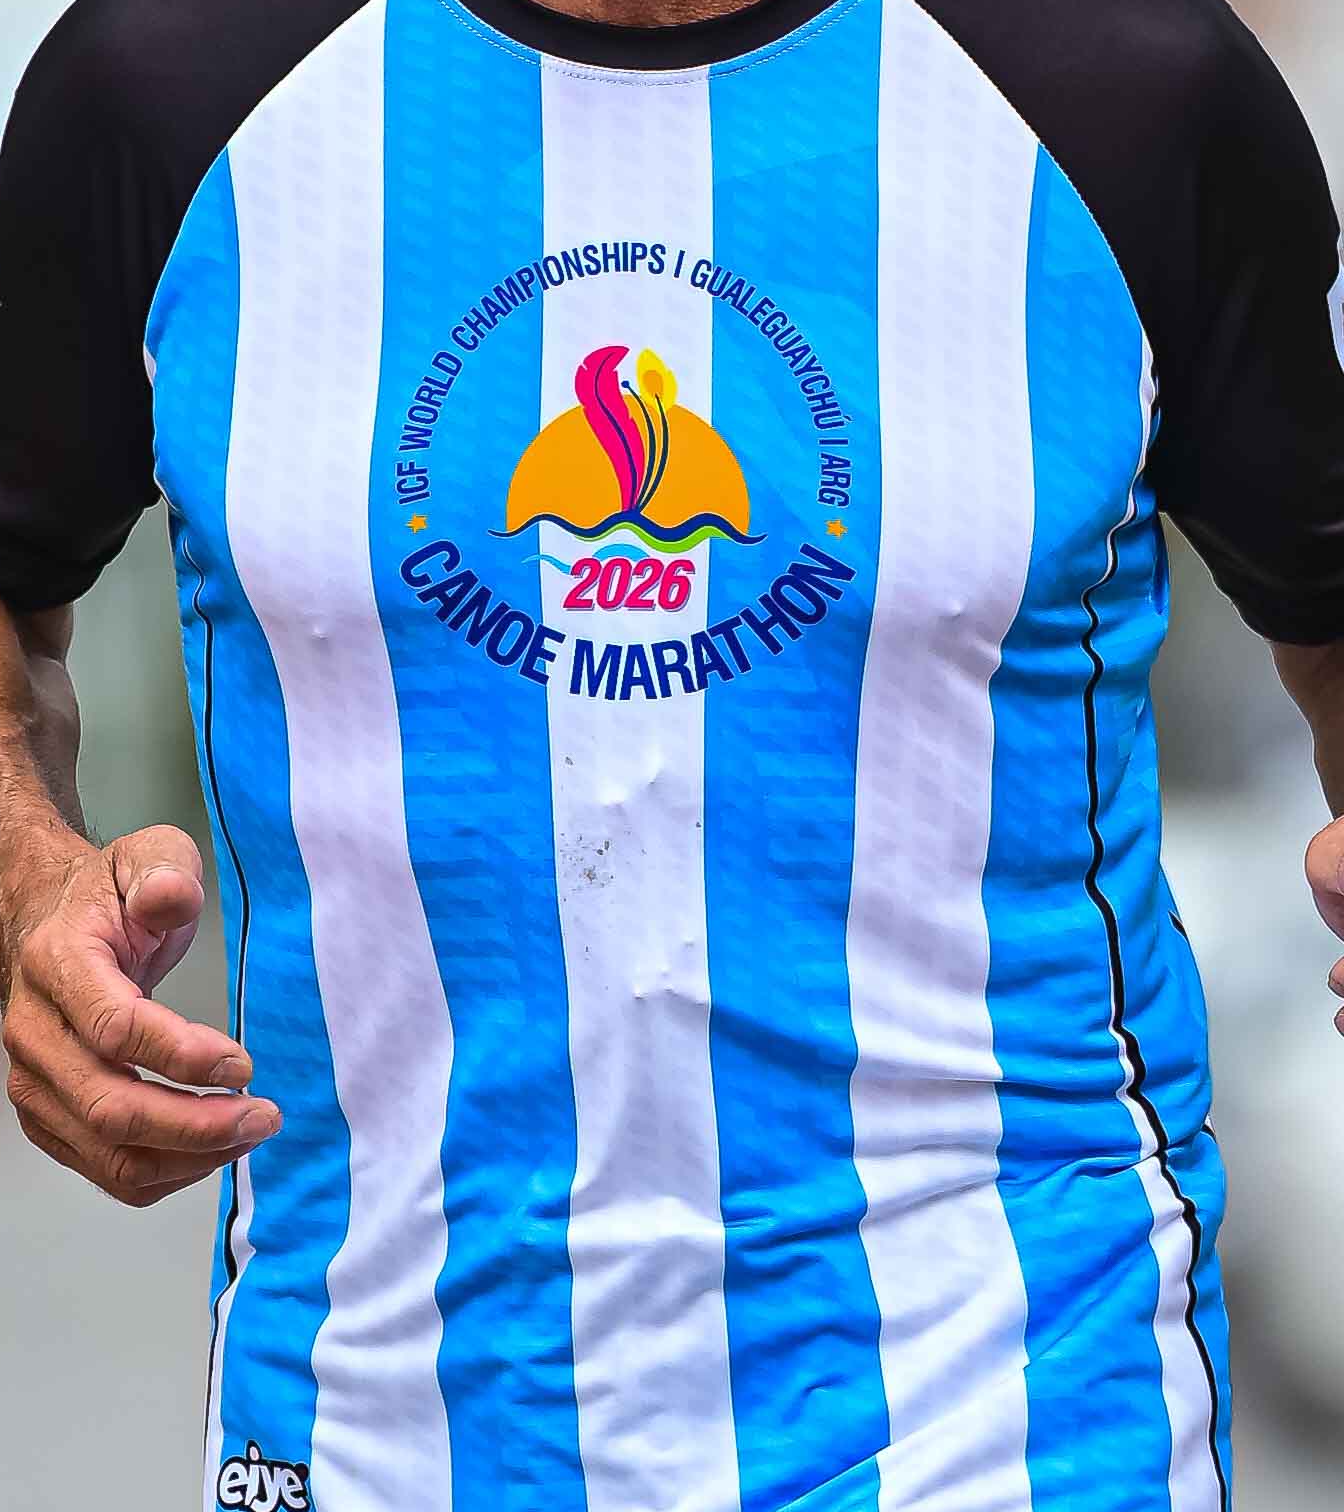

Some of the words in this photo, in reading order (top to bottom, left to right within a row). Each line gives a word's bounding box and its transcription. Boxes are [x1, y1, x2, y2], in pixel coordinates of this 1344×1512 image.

[450, 241, 667, 353] CHAMPIONSHIPS
[689, 258, 852, 431] GUALEGUAYCHÚ
[398, 350, 463, 453] WORLD
[395, 461, 431, 506] ICF
[817, 451, 851, 508] ARG
[400, 539, 567, 686] CANOE
[568, 543, 858, 701] MARATHON
[563, 557, 696, 612] 2026
